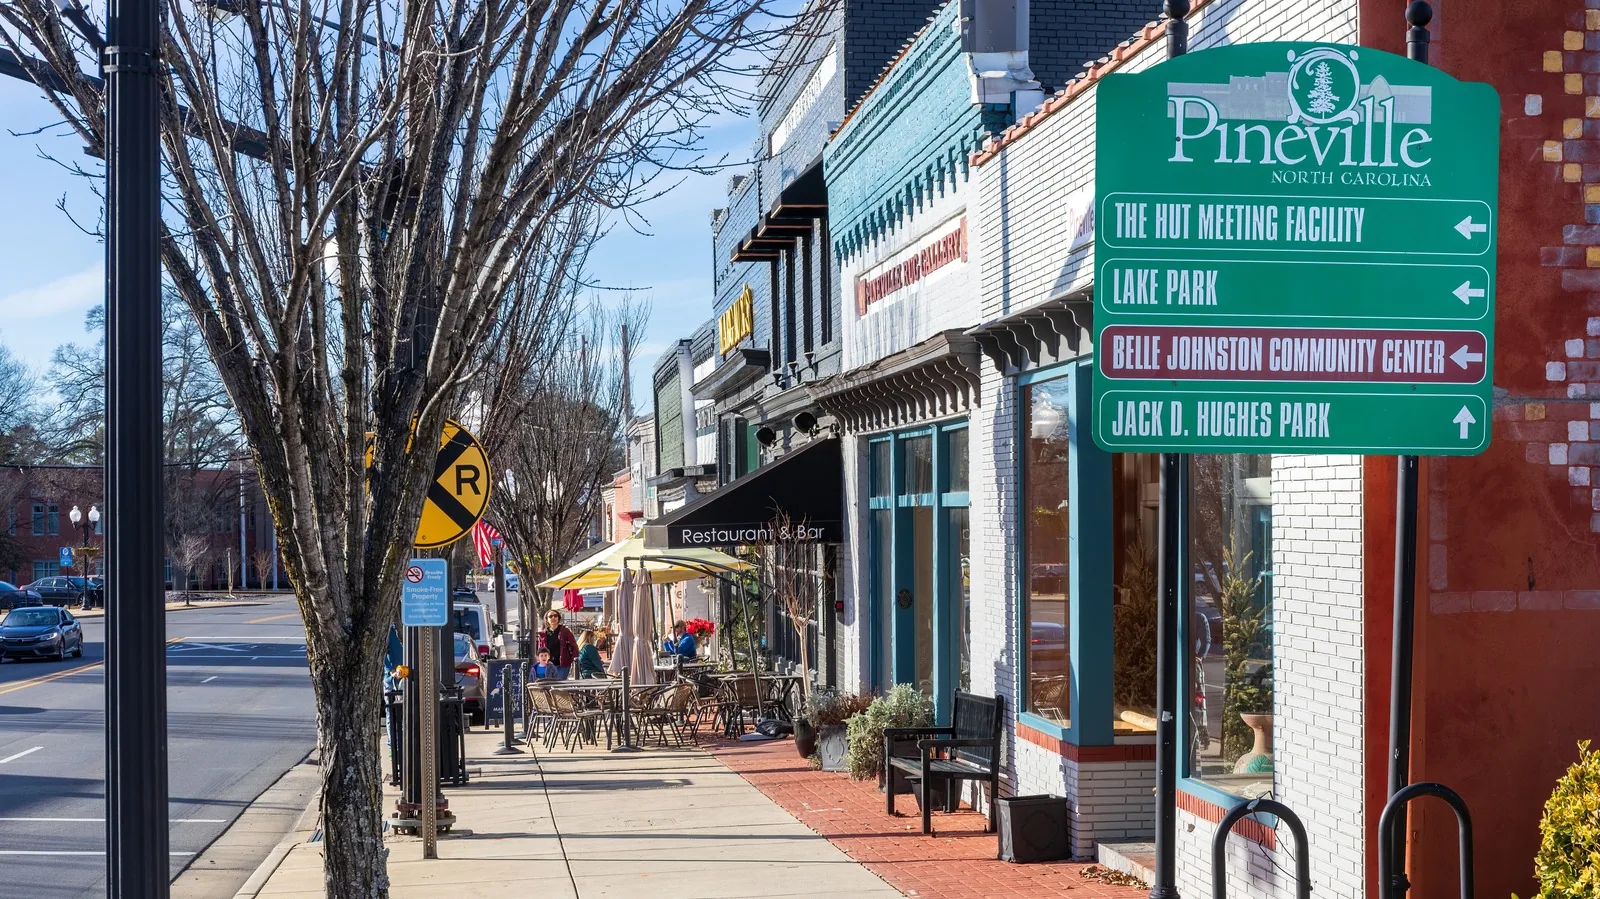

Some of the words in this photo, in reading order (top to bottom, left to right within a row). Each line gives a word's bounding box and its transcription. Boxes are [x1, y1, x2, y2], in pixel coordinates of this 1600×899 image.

[1168, 95, 1432, 168] Pineville
[1271, 170, 1334, 185] NORTH
[1341, 172, 1432, 187] CAROLINA
[1115, 203, 1147, 239] THE
[1155, 203, 1190, 239] HUT
[1198, 204, 1278, 241] MEETING
[1286, 206, 1365, 243] FACILITY
[921, 228, 961, 277] GALLERY
[1113, 268, 1158, 305] LAKE
[1167, 270, 1218, 306] PARK
[1113, 335, 1160, 370] BELLE
[1167, 336, 1262, 372] JOHNSTON
[1269, 337, 1376, 373] COMMUNITY
[1382, 339, 1445, 374] CENTER
[1112, 401, 1163, 437] JACK
[1171, 401, 1188, 437] D.
[1198, 401, 1271, 438] HUGHES
[1280, 402, 1330, 438] PARK
[456, 464, 481, 496] R
[682, 527, 774, 544] Restaurant
[779, 526, 791, 540] &
[797, 524, 825, 539] Bar
